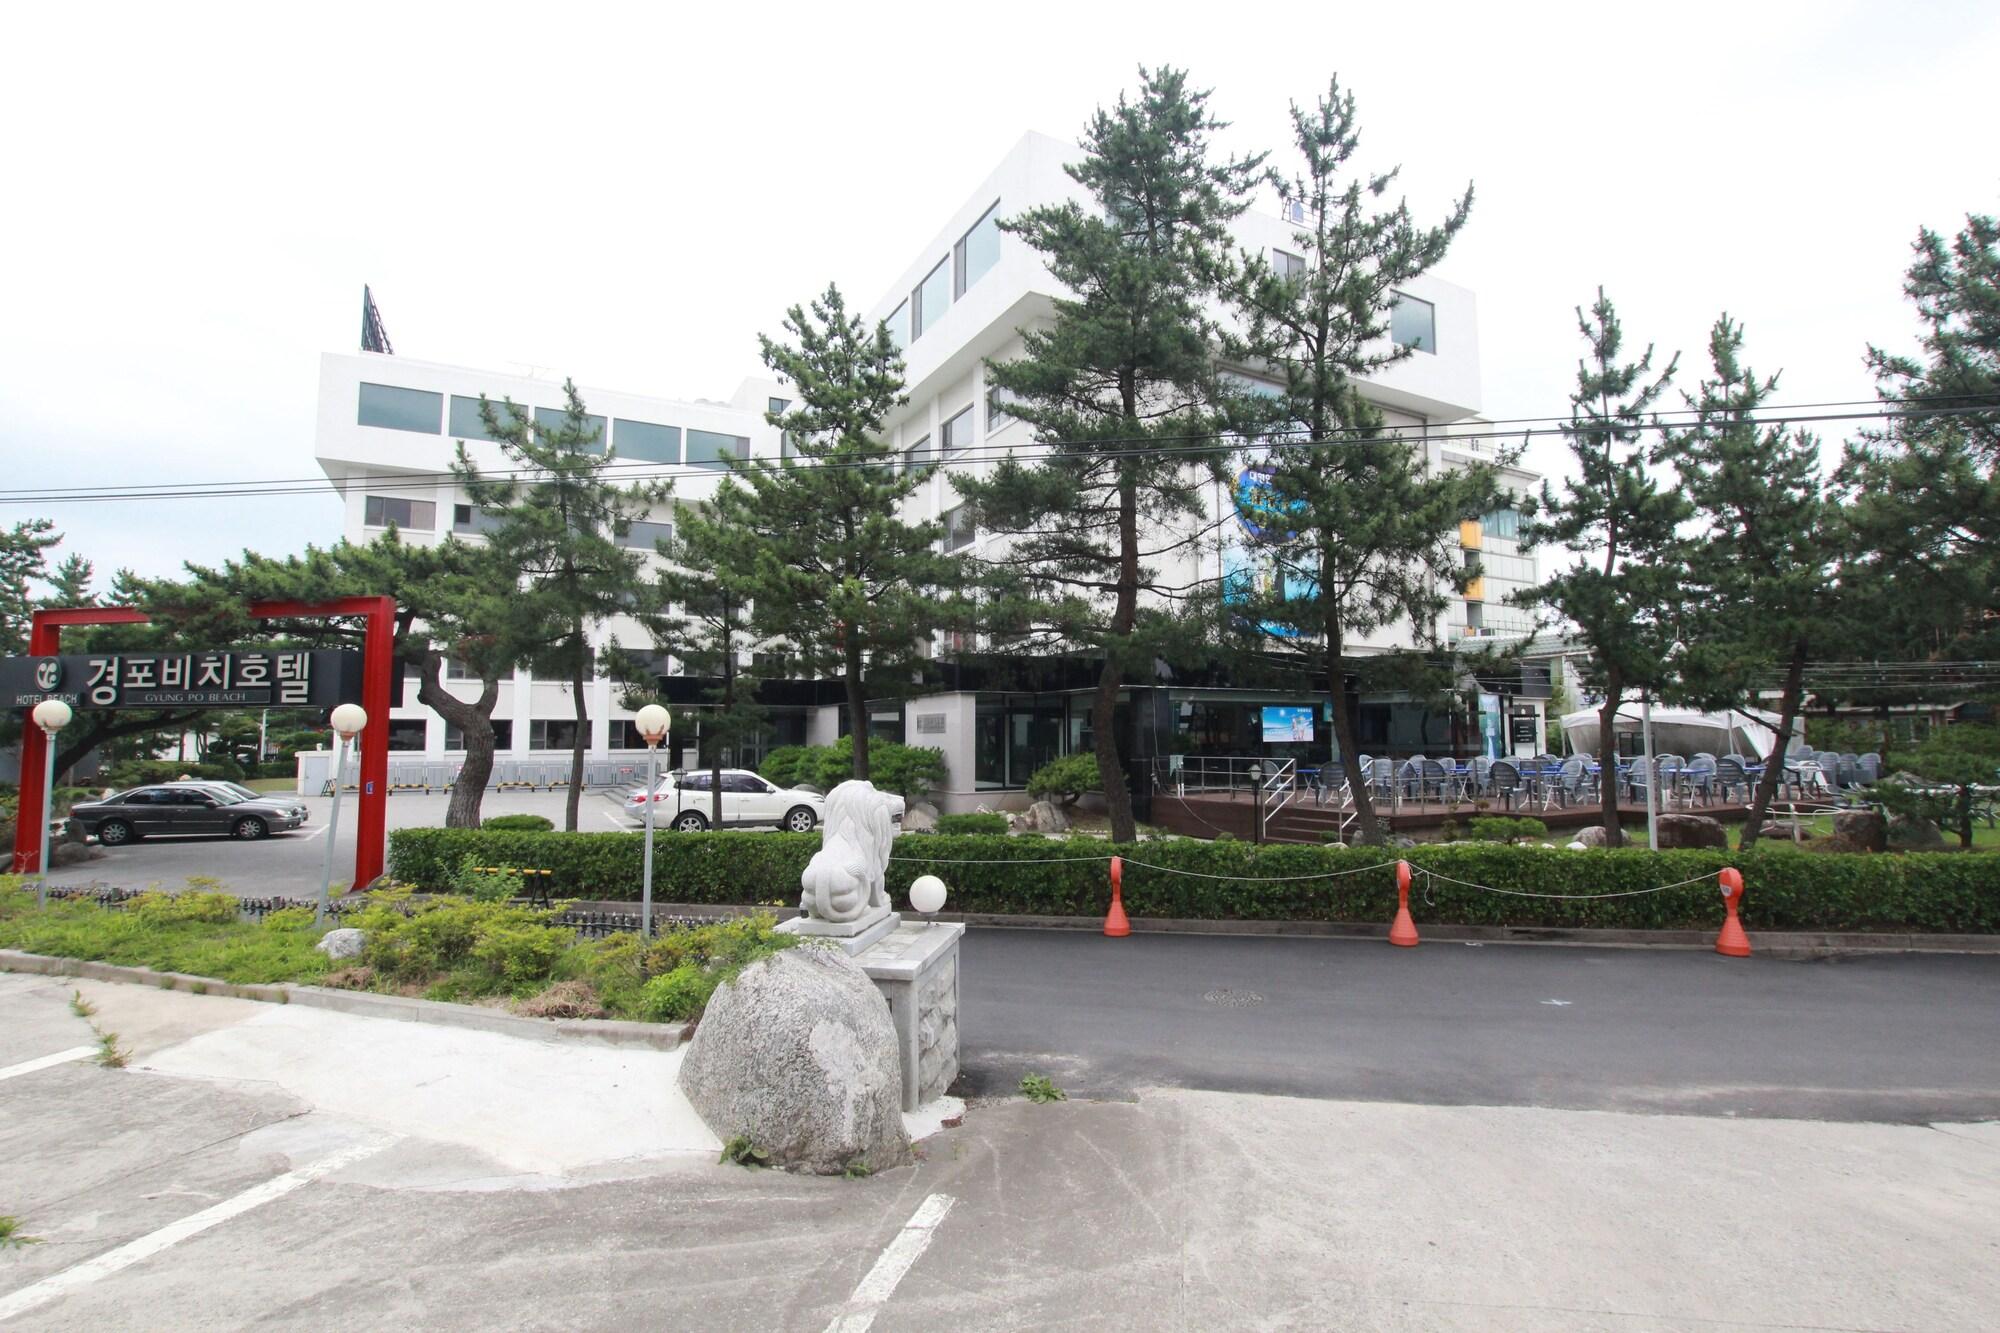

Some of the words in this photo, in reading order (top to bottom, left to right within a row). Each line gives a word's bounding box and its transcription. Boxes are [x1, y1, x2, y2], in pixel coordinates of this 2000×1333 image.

[86, 652, 309, 705] 경포비치호텔
[16, 694, 43, 705] HOTEL
[47, 693, 78, 704] BEACH
[145, 693, 184, 702] GYUNG
[188, 693, 204, 702] PO
[208, 692, 246, 702] BEACH
